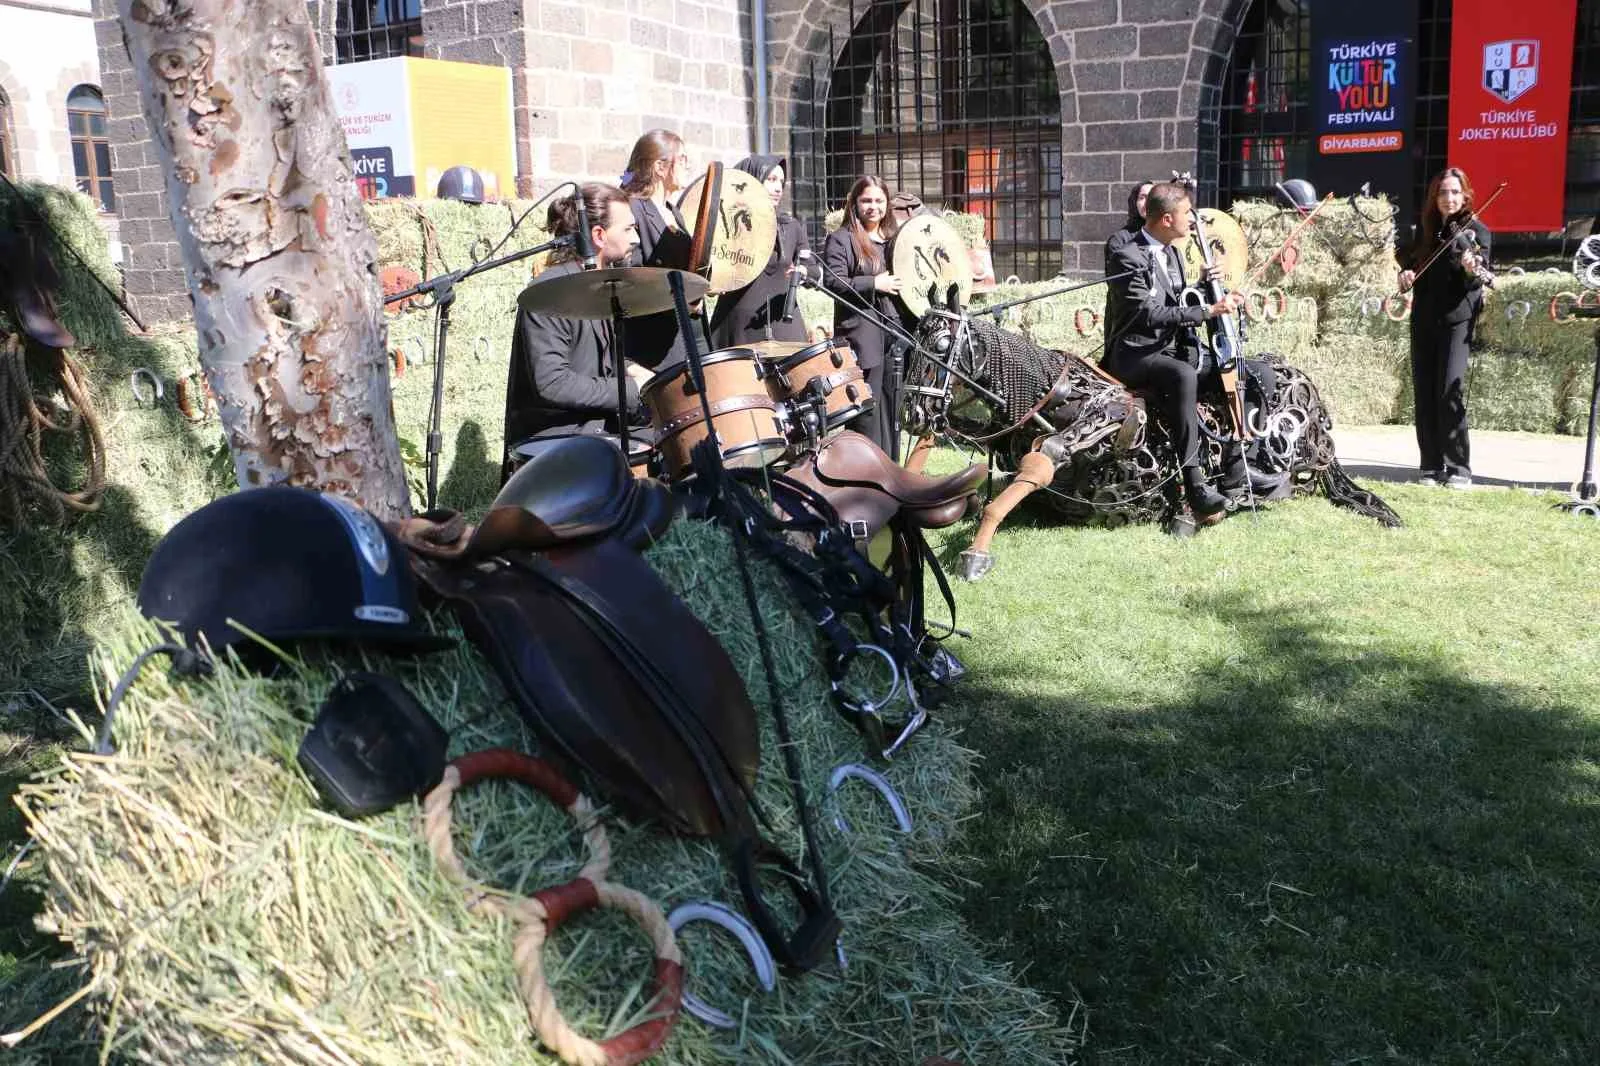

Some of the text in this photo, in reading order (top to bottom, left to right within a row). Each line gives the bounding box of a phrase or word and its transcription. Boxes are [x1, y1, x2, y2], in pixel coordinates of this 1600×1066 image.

[1330, 41, 1397, 60] TÜRKİYE
[1328, 58, 1397, 90] KÜLTÜR
[1337, 82, 1389, 111] YOLU
[1328, 107, 1395, 124] FESTİVALİ
[1480, 110, 1537, 124] TÜRKİYE
[1459, 123, 1557, 140] JOKEY KULÜBÜ
[1323, 136, 1398, 150] DİYARBAKIR
[353, 155, 386, 174] KİYE
[717, 243, 755, 266] Senfoni
